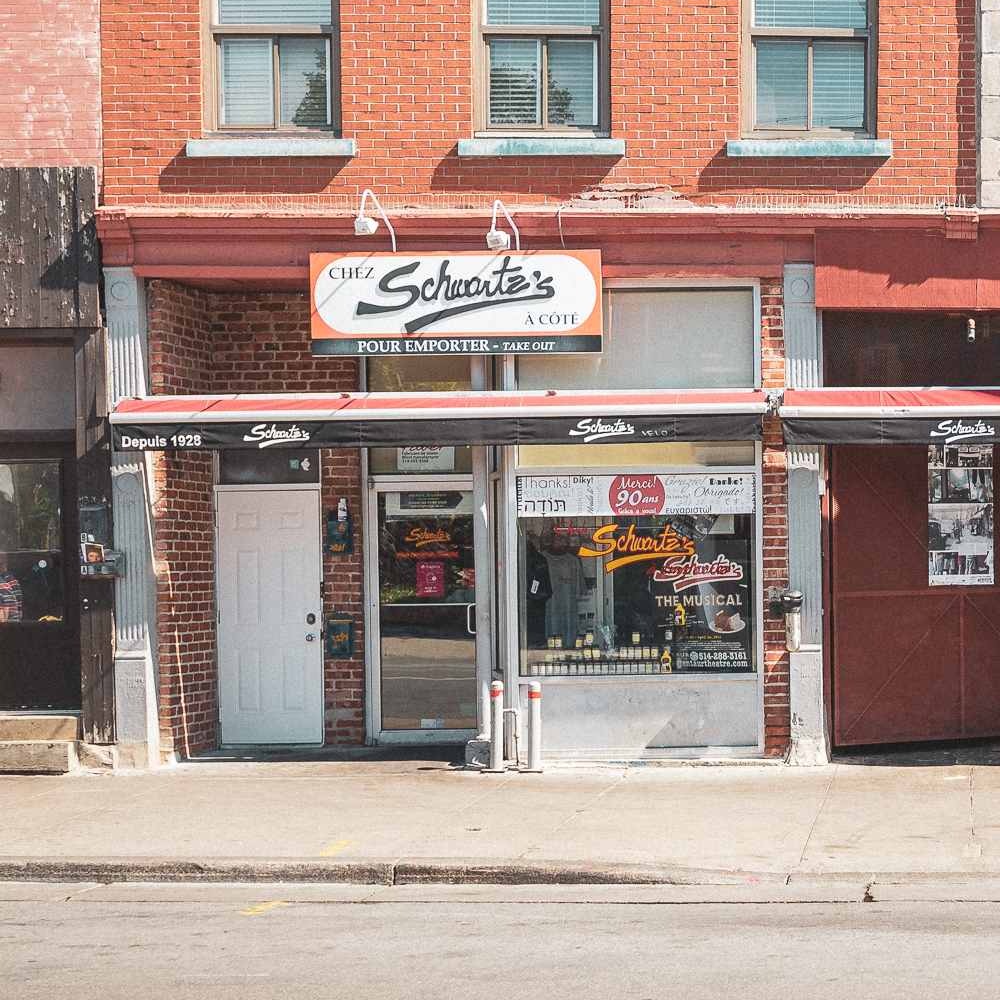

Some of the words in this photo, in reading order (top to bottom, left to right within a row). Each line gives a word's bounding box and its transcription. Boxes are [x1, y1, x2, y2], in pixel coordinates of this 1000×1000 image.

[329, 266, 375, 280] CHEZ
[356, 256, 555, 335] Schwartz's
[524, 311, 534, 325] À
[539, 311, 579, 325] CÔTÉ
[357, 339, 400, 353] POUR
[404, 339, 490, 352] EMPORTER
[502, 342, 530, 351] TAKE
[532, 341, 556, 350] OUT
[243, 423, 310, 449] Schwartz's
[569, 418, 635, 443] Schwartz's
[930, 419, 995, 444] Schwartz's
[121, 435, 167, 450] Depuis
[171, 434, 201, 447] 1928
[524, 476, 571, 489] Thanks!
[617, 475, 656, 490] Merci!
[664, 475, 708, 493] Grazie!
[709, 477, 743, 486] Danke!
[615, 489, 642, 508] 90
[642, 494, 659, 503] ans
[693, 486, 744, 499] Obrigado!
[554, 521, 588, 535] Chez
[578, 523, 695, 573] Schwartz's
[655, 595, 679, 607] THE
[683, 593, 743, 607] MUSICAL
[698, 651, 748, 660] 514-288-3161
